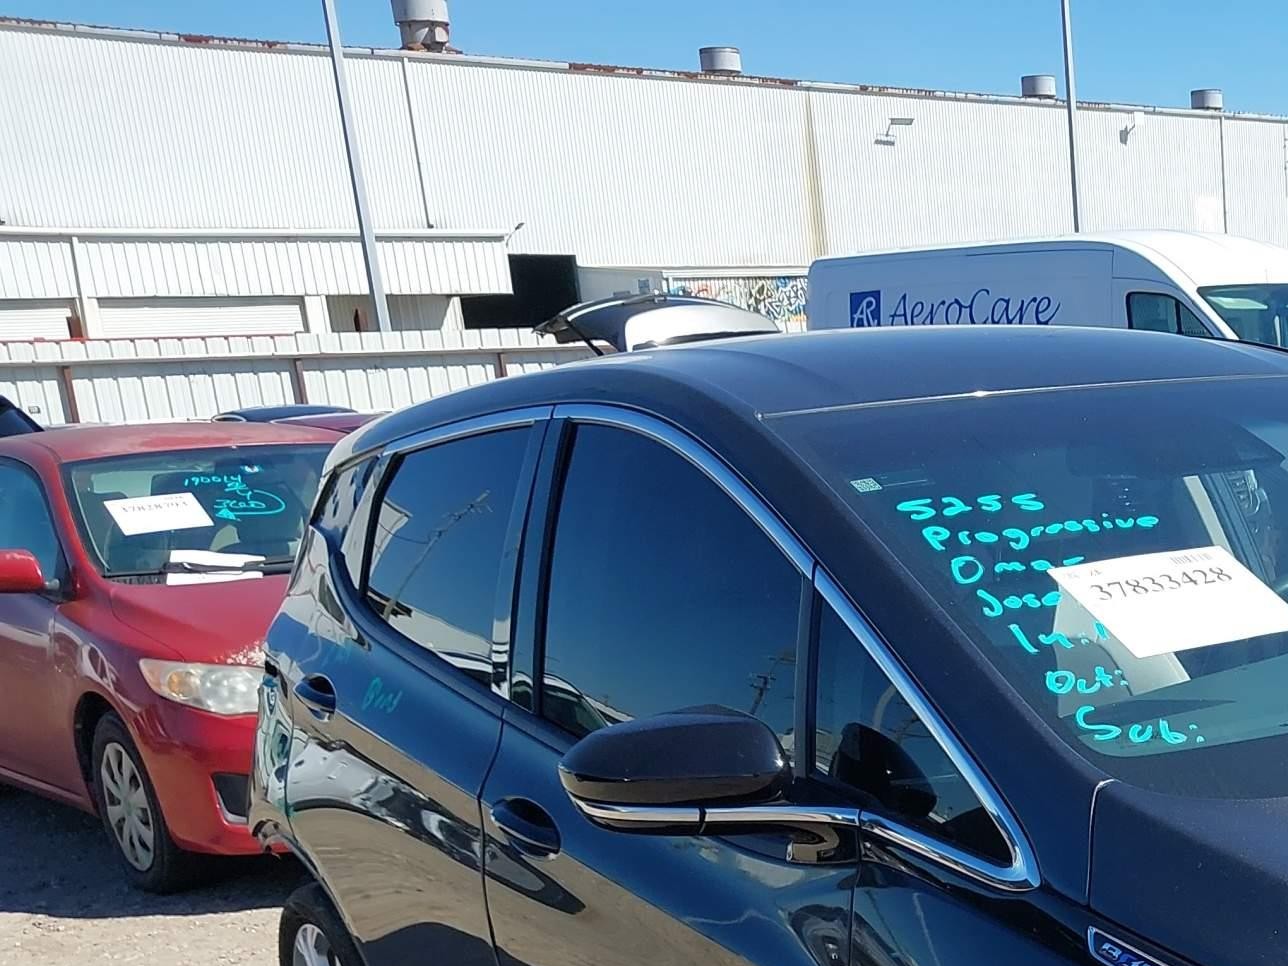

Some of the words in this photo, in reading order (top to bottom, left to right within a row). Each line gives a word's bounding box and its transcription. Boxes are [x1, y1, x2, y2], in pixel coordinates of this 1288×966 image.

[889, 288, 1061, 325] AeroCare
[922, 513, 1160, 551] Progressive
[1090, 566, 1233, 601] 37833428
